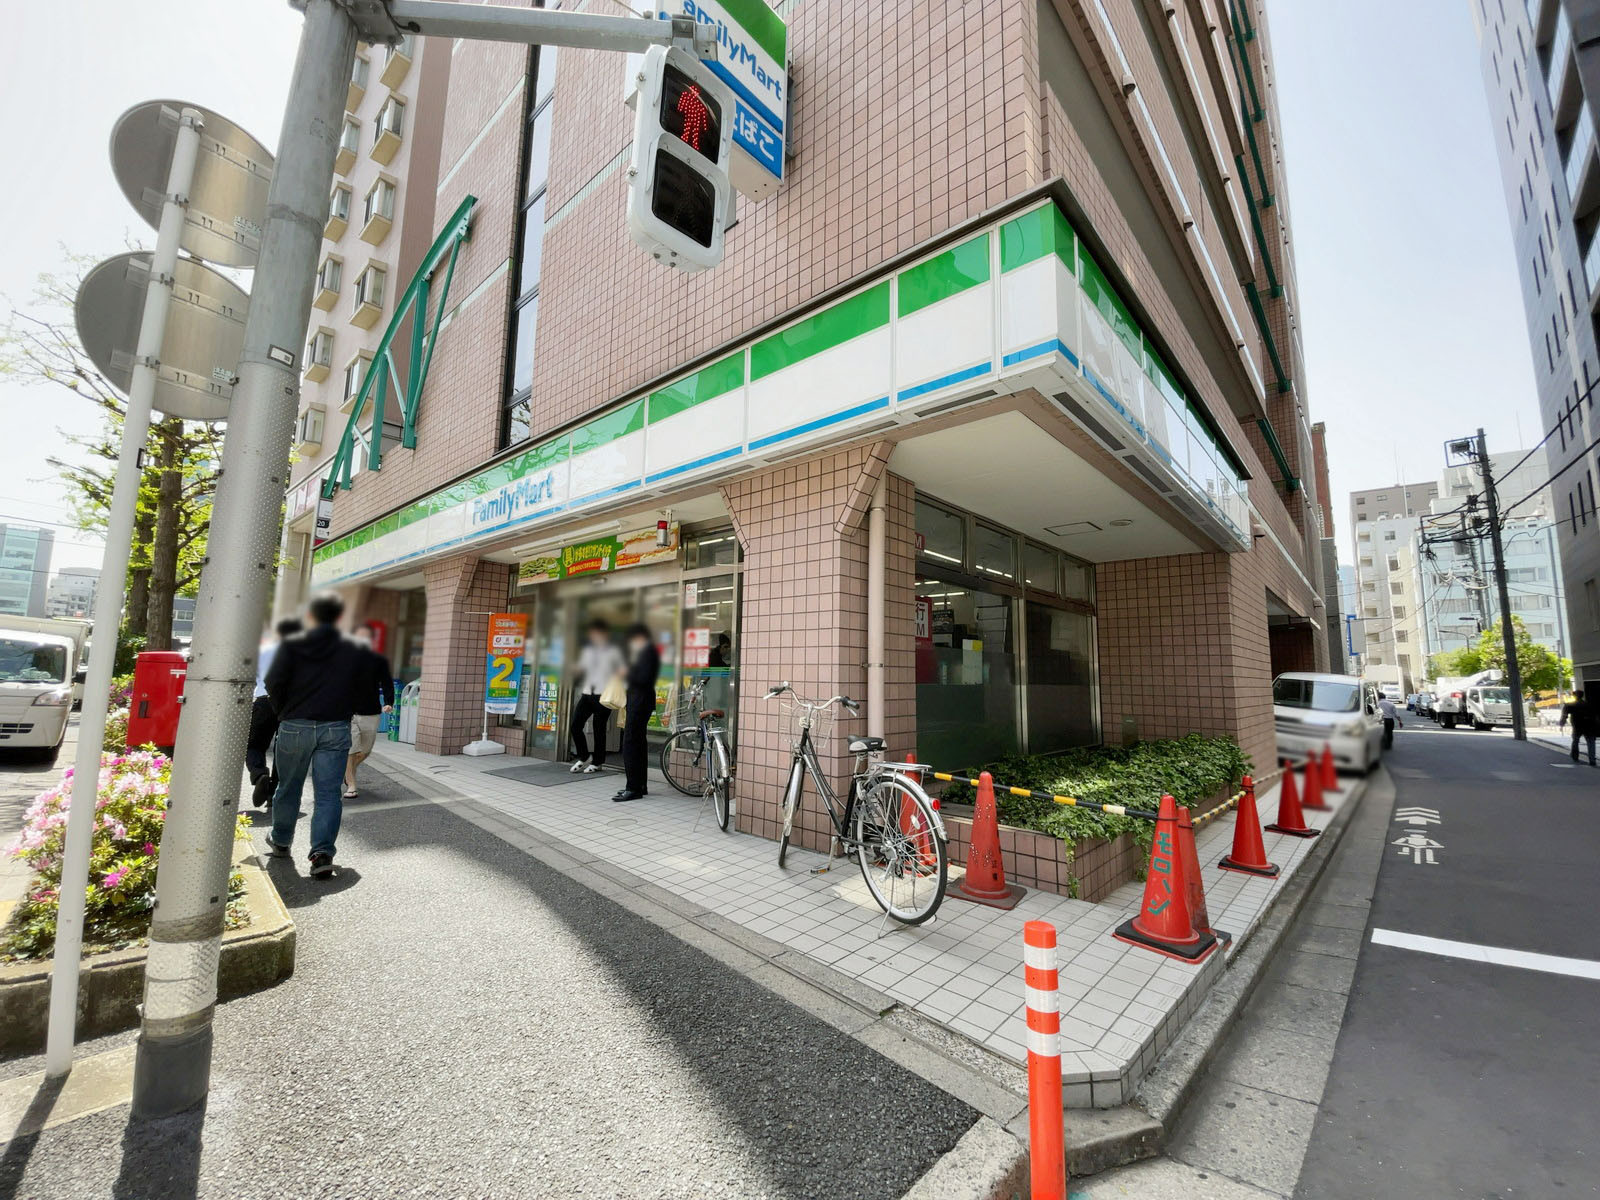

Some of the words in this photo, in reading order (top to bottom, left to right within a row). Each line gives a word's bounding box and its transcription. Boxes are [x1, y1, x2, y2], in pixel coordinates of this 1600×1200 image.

[684, 0, 782, 100] amilyMart
[735, 111, 775, 162] ばこ
[473, 471, 553, 525] FamilyMart
